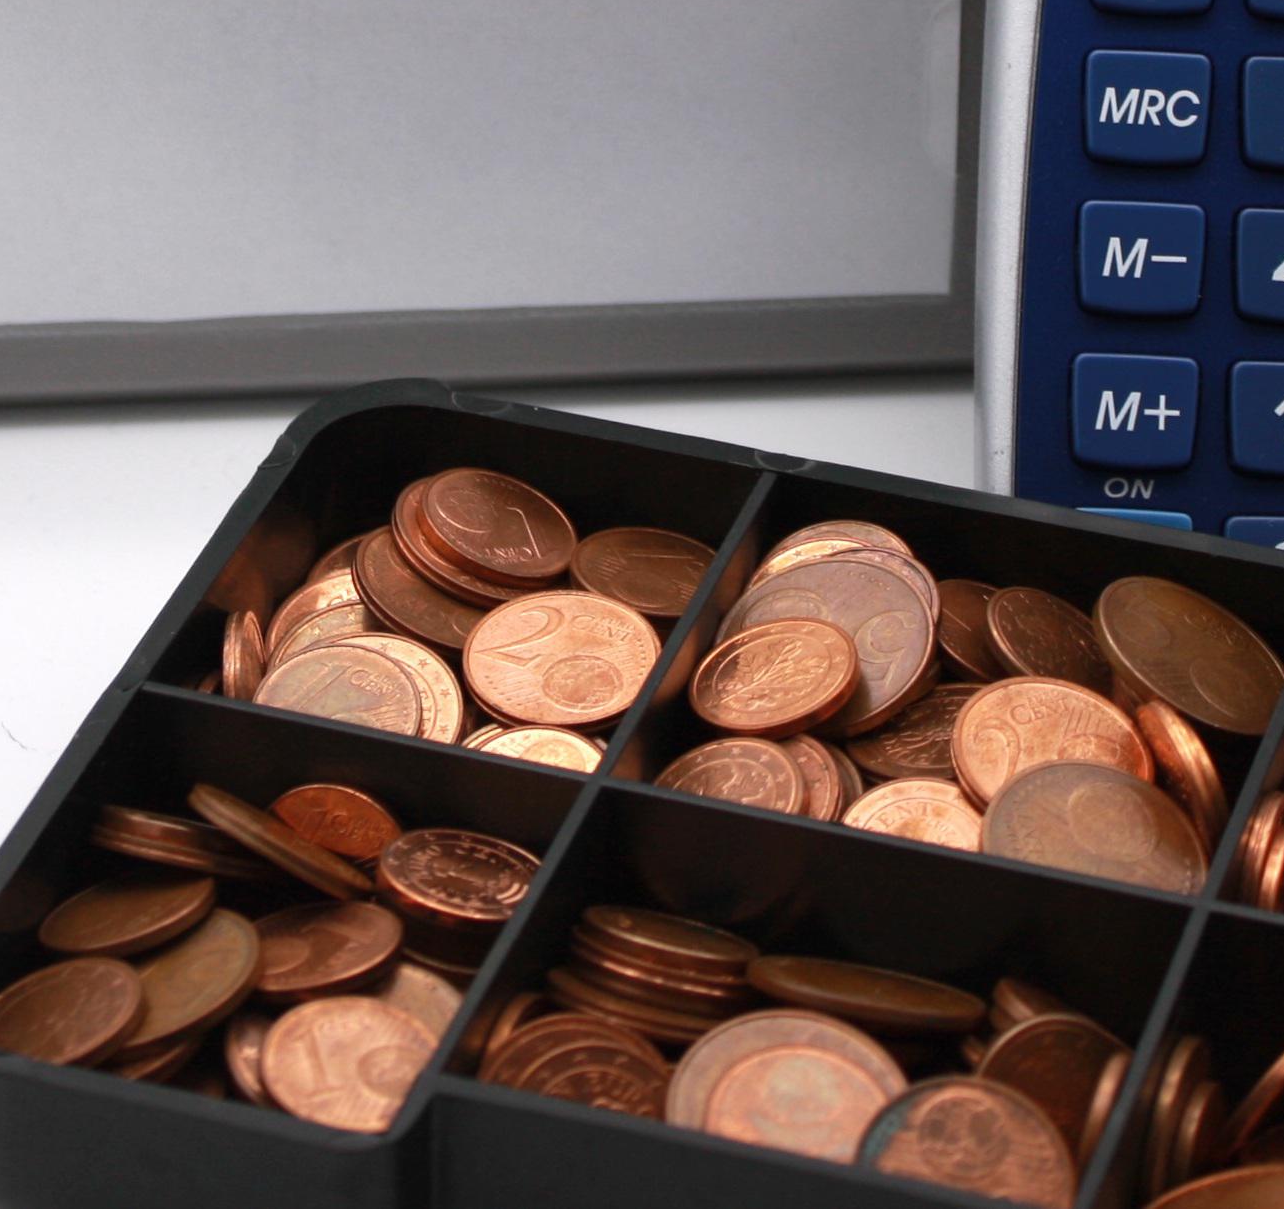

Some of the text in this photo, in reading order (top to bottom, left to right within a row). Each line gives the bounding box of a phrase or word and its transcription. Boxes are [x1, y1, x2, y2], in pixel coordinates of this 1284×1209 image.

[1099, 86, 1201, 128] MRC
[1095, 390, 1181, 432] M+
[1103, 479, 1156, 500] ON
[472, 606, 565, 668] 2
